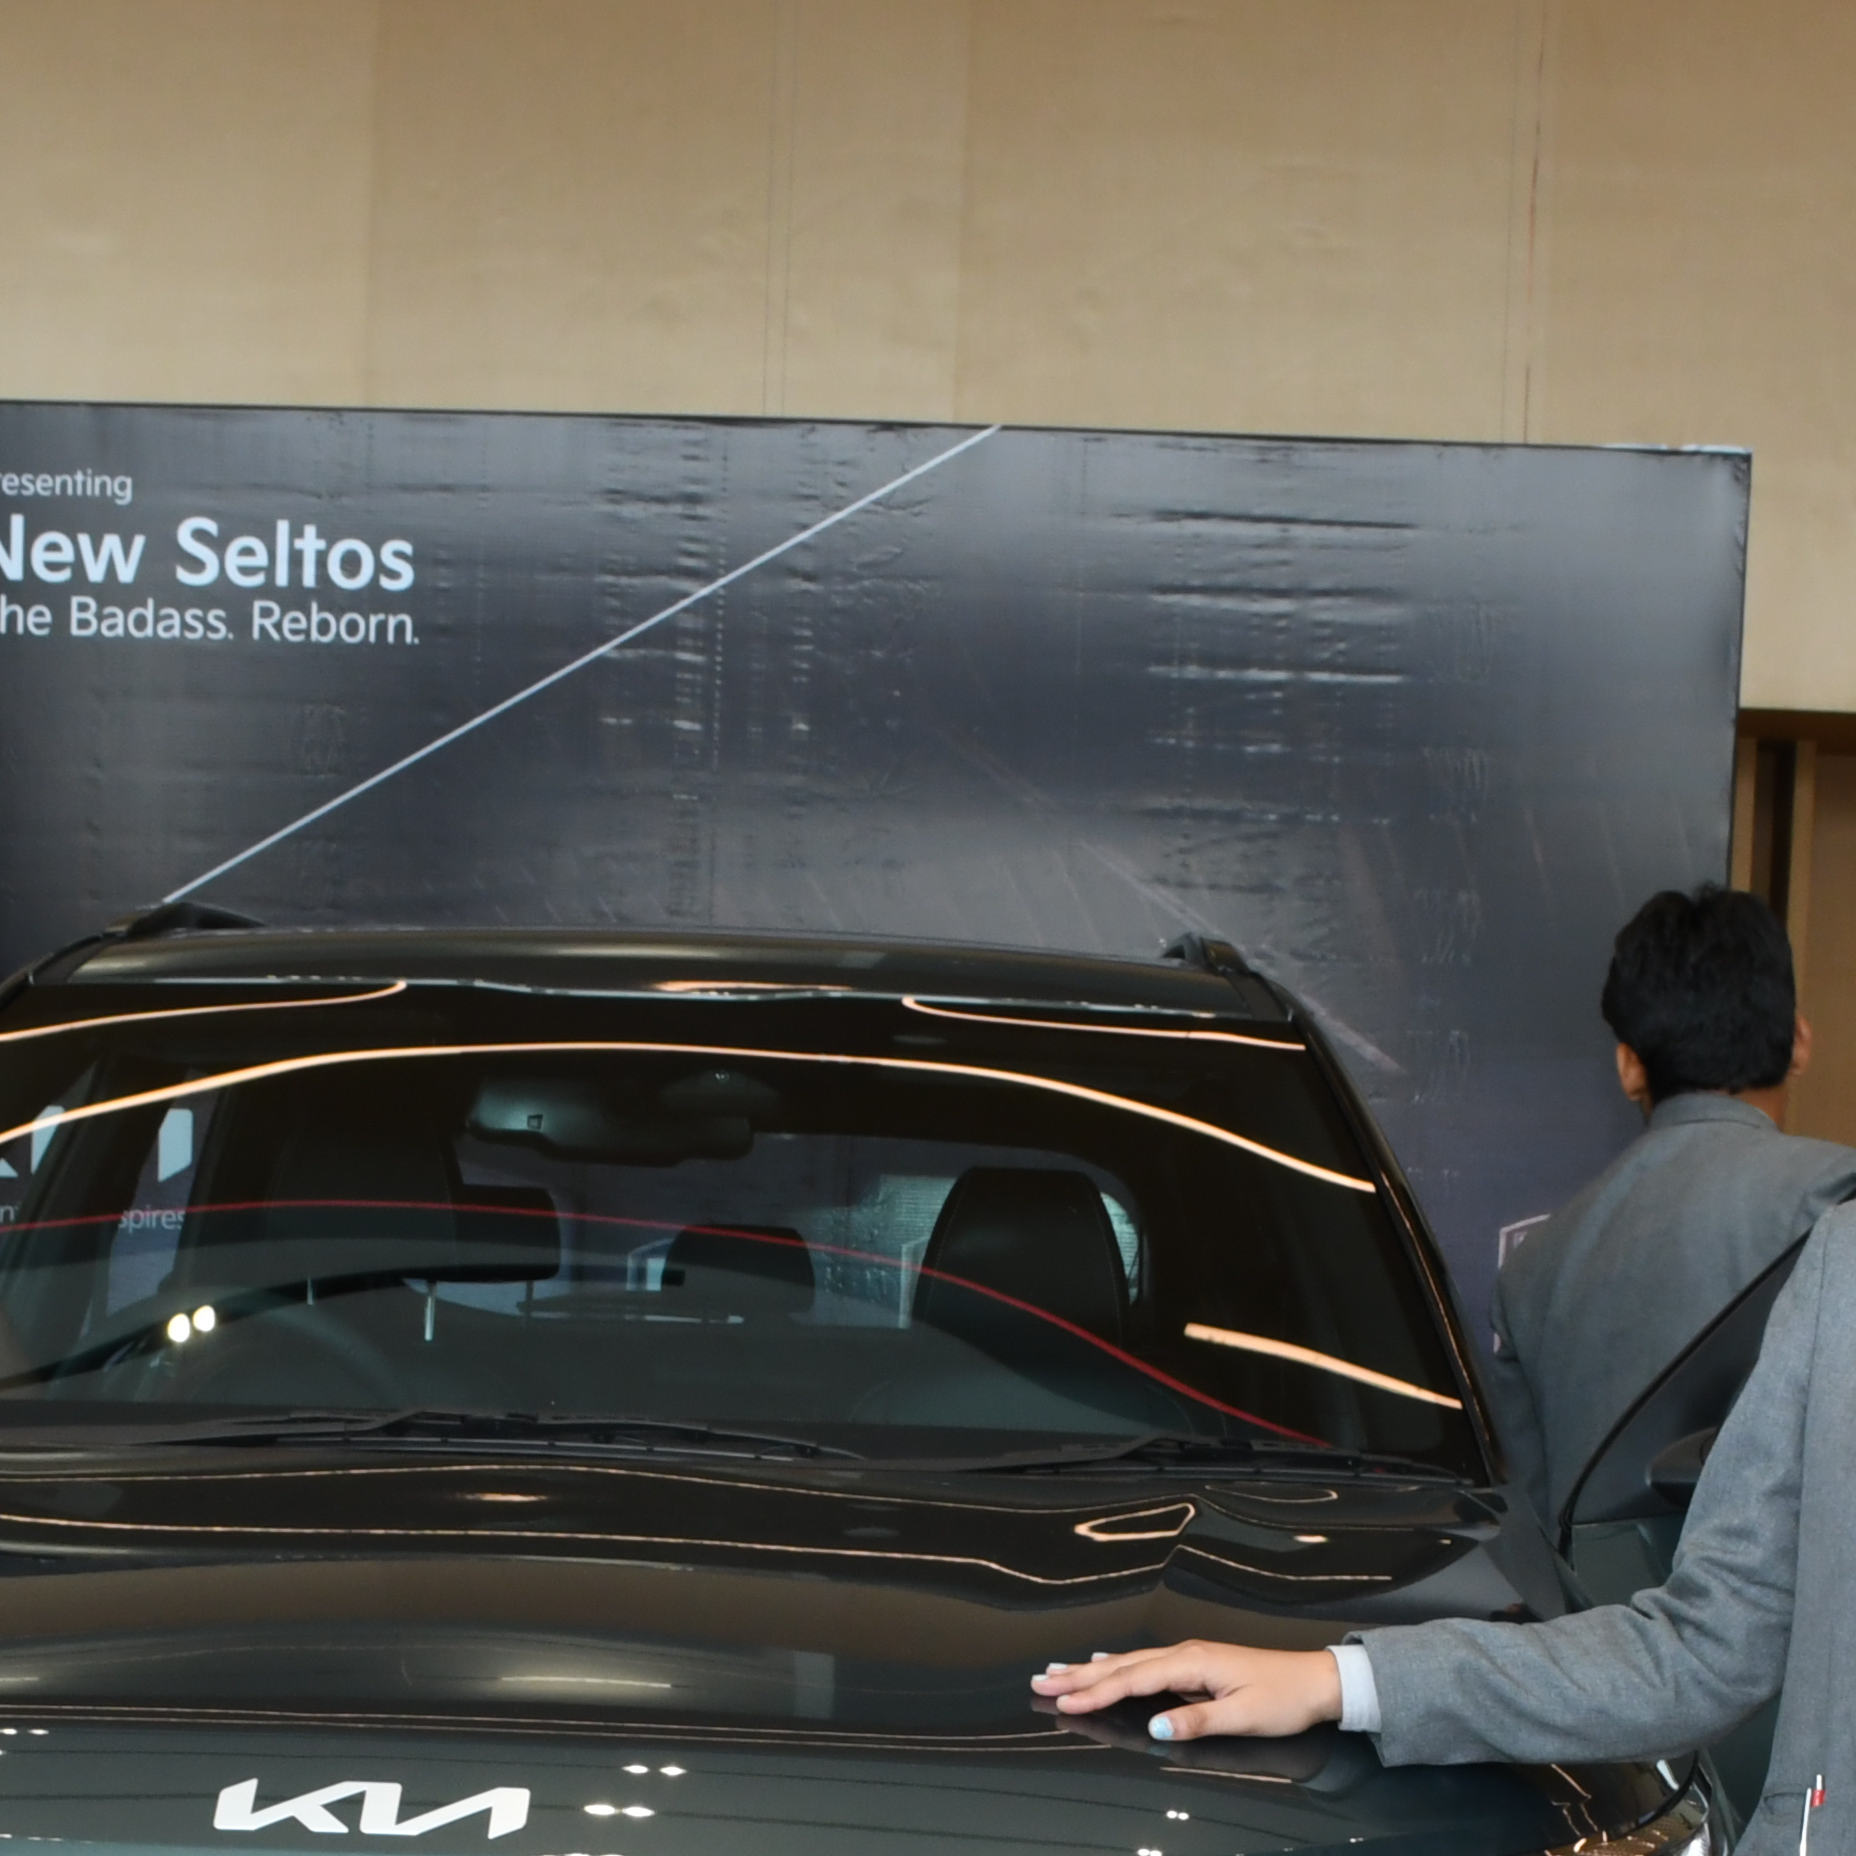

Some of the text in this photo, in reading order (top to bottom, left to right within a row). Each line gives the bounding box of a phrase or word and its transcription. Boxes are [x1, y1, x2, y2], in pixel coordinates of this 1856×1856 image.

[175, 516, 415, 591] Seltos
[70, 595, 234, 640] Badass.
[252, 599, 420, 644] Reborn.
[213, 1777, 531, 1840] KIA
